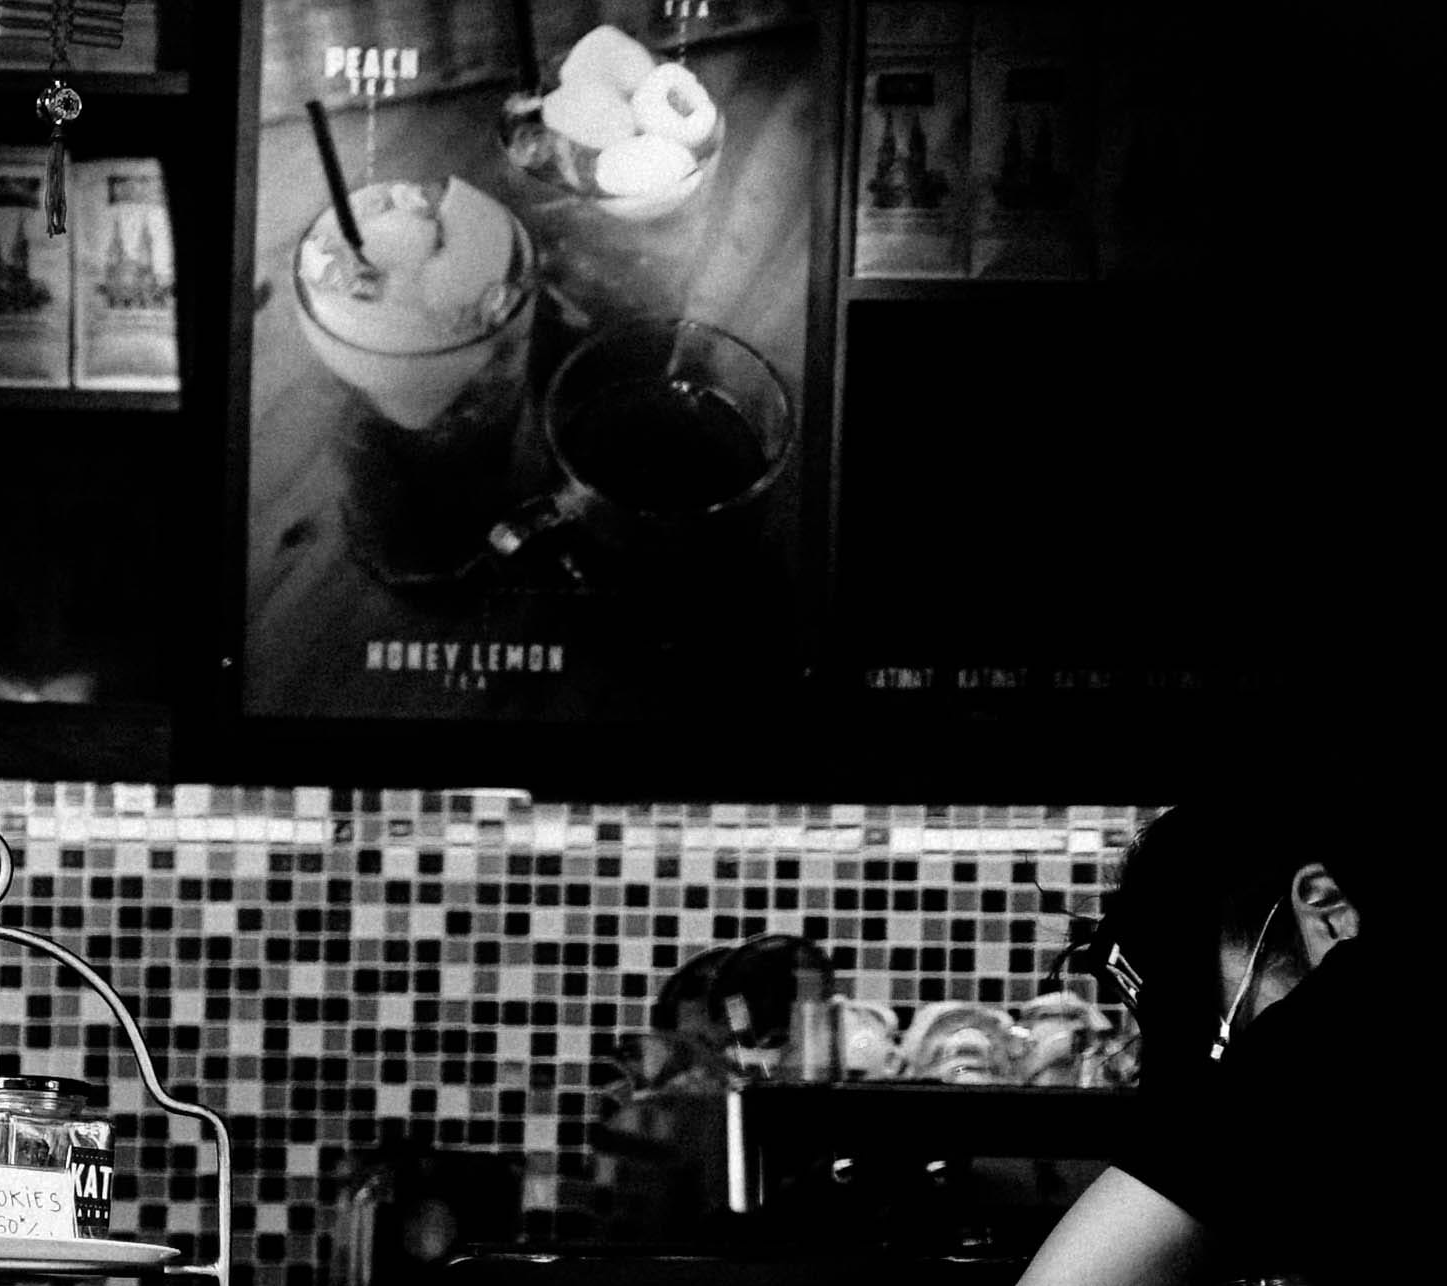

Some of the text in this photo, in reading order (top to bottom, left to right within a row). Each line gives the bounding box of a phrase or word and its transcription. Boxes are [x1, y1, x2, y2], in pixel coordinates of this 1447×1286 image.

[324, 47, 417, 78] PEACH
[366, 641, 564, 673] HONEY LEMON
